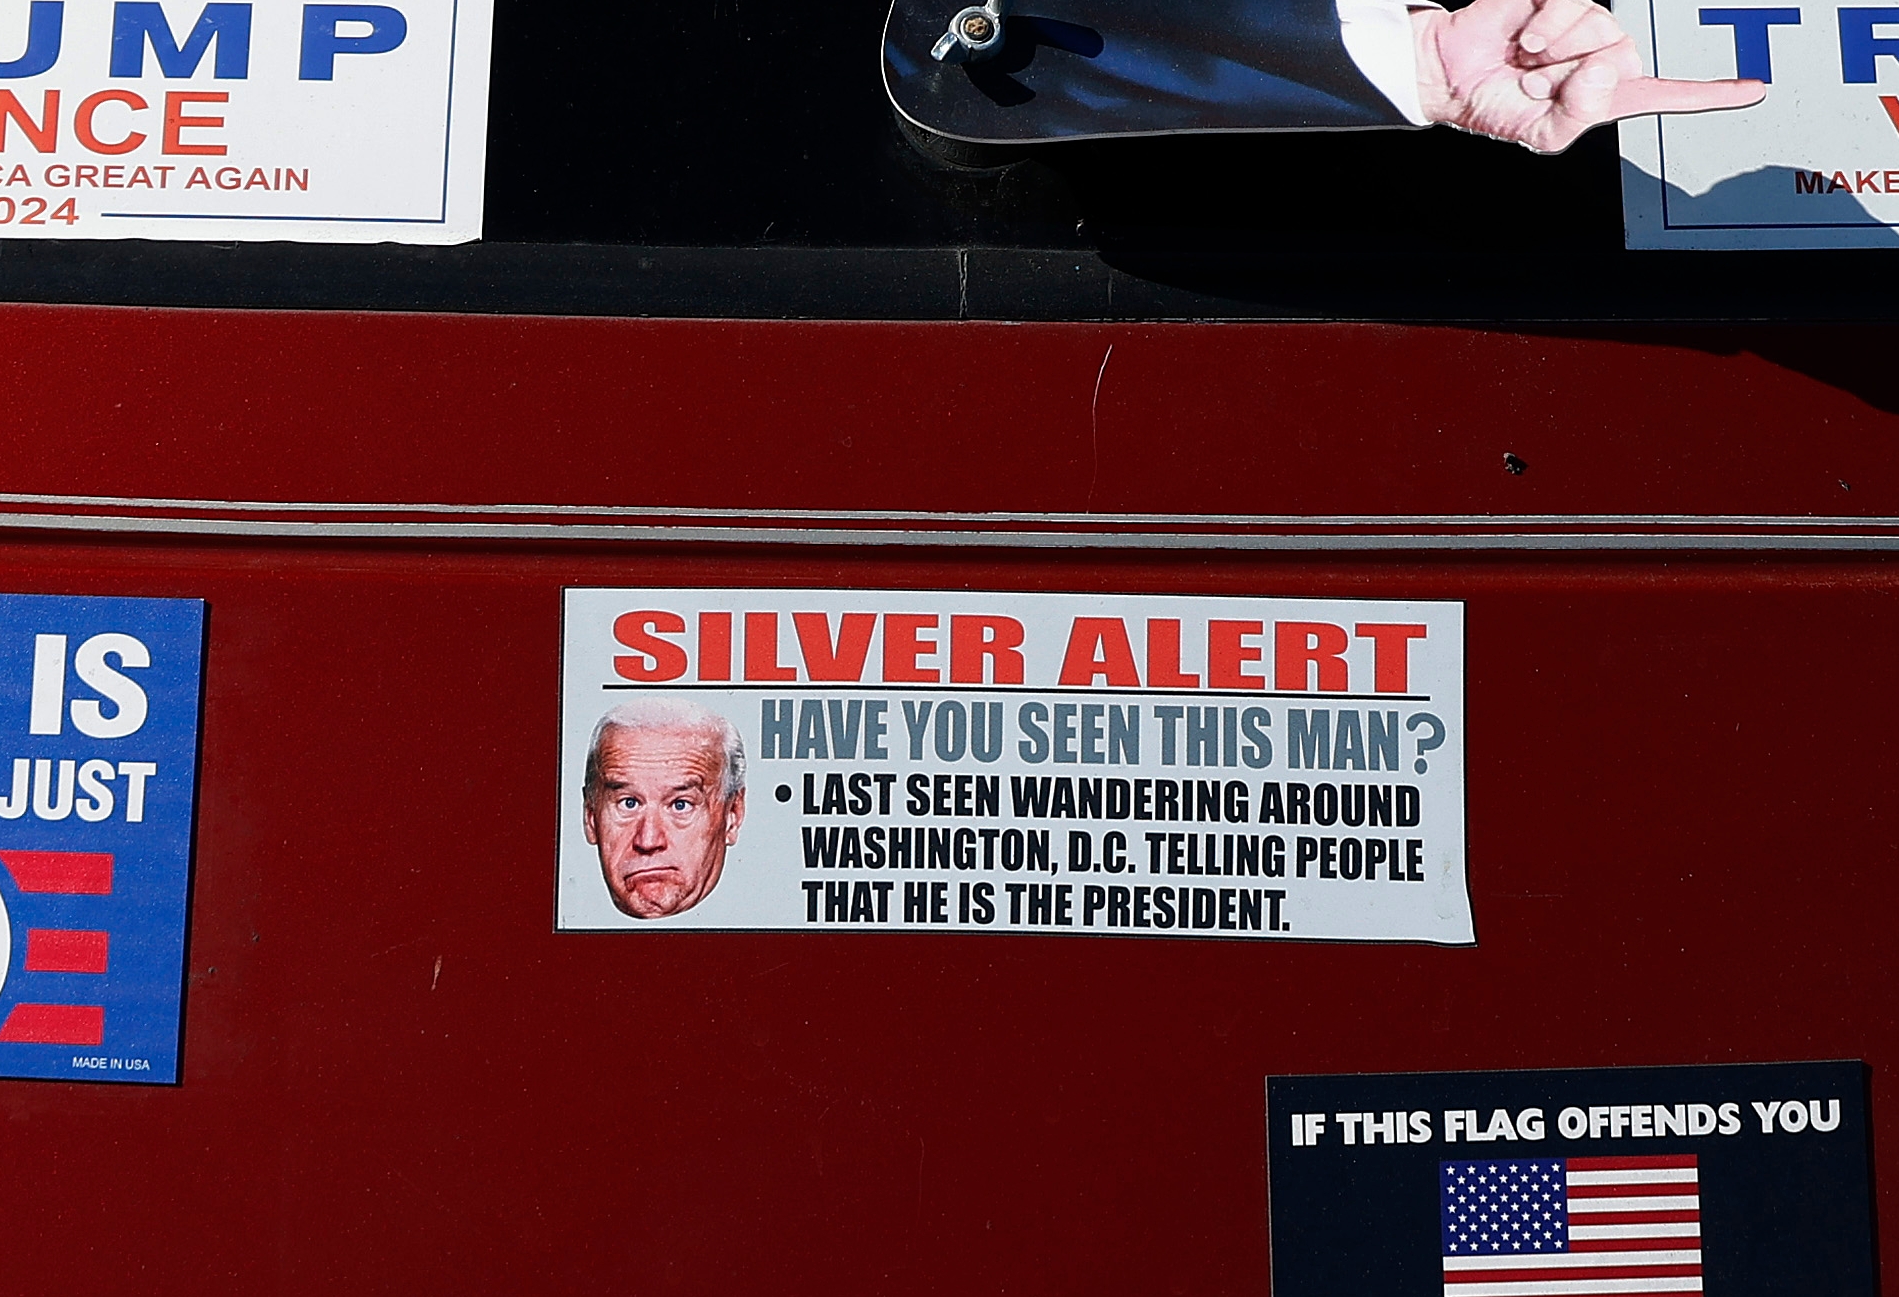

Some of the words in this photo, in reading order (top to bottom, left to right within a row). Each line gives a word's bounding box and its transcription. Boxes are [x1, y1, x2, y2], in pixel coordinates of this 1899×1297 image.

[45, 165, 175, 188] GREAT
[185, 167, 308, 191] AGAIN
[613, 611, 1024, 684] SILVER
[1059, 615, 1428, 694] ALERT
[30, 633, 151, 738] IS
[761, 699, 888, 759] HAVE
[902, 700, 1003, 763] YOU
[1019, 702, 1139, 765] SEEN
[1154, 706, 1272, 769] THIS
[1296, 708, 1447, 775] MAN?
[803, 773, 896, 815] LAST
[907, 774, 999, 816] SEEN
[1011, 776, 1248, 823] WANDERING
[1259, 782, 1420, 827] AROUND
[802, 827, 1058, 876] WASHINGTON,
[1069, 831, 1135, 873] D.C.
[1145, 833, 1285, 877] TELLING
[1296, 837, 1424, 881] PEOPLE
[802, 881, 894, 922] THAT
[904, 882, 948, 923] HE
[959, 882, 995, 924] IS
[1005, 883, 1072, 925] THE
[1083, 885, 1290, 931] PRESIDENT.
[73, 1057, 107, 1068] MADE
[110, 1059, 122, 1069] IN
[125, 1059, 150, 1070] USA
[1292, 1114, 1325, 1146] IF
[1336, 1111, 1432, 1144] THIS
[1445, 1108, 1545, 1142] FLAG
[1558, 1103, 1741, 1139] OFFENDS
[1751, 1099, 1840, 1133] YOU
